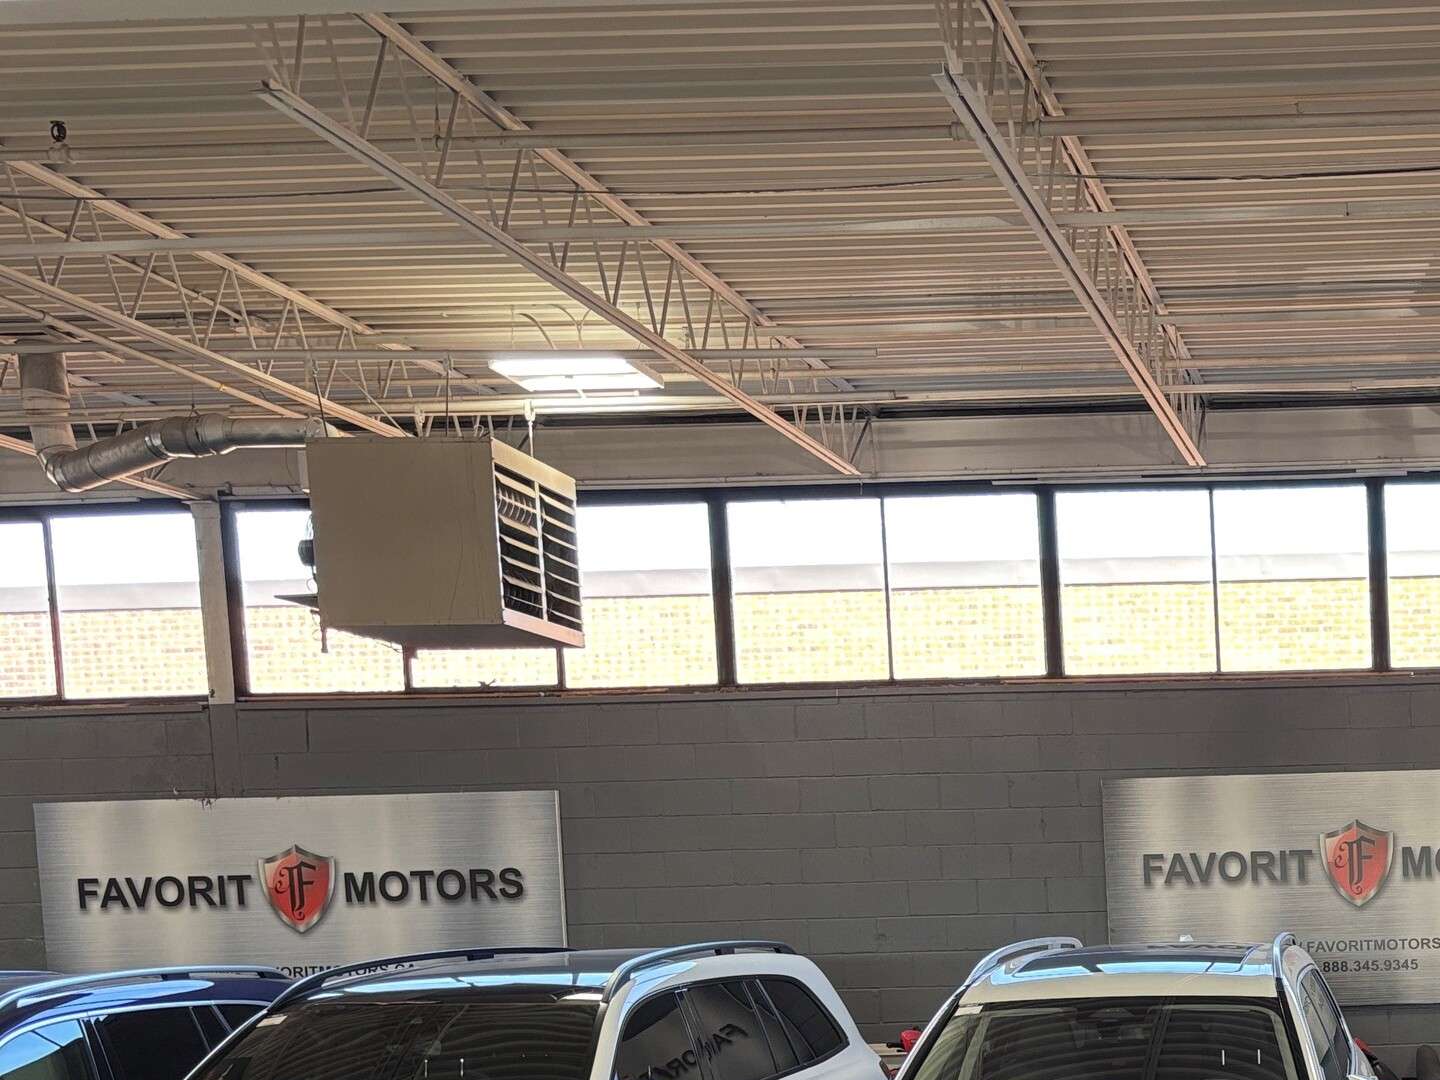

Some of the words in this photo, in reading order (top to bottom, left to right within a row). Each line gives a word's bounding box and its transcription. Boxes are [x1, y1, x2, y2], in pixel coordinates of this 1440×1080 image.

[77, 873, 252, 909] FAVORIT
[343, 867, 525, 904] MOTORS
[1142, 849, 1313, 887] FAVORIT
